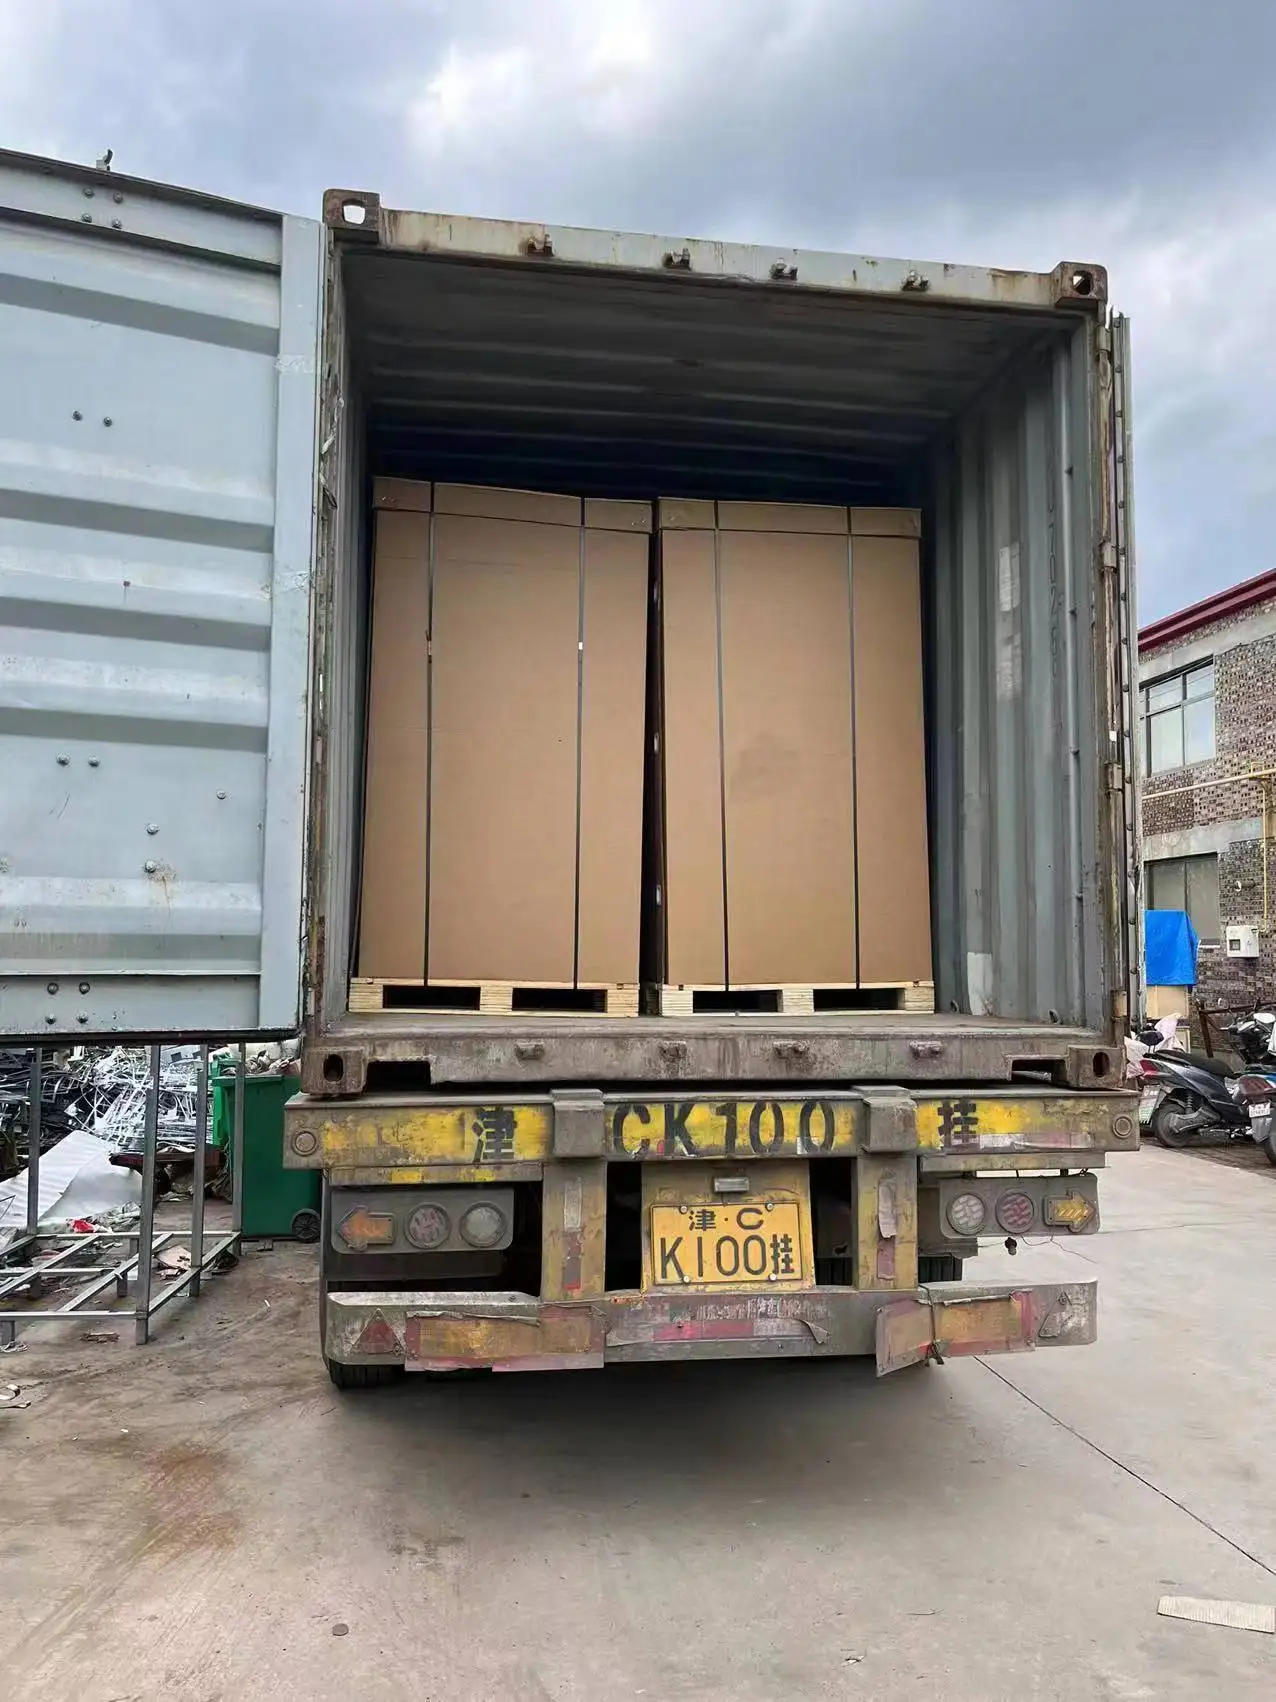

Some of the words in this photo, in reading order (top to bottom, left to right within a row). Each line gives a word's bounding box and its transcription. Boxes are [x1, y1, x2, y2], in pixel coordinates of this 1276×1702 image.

[472, 1105, 518, 1164] 津
[612, 1100, 836, 1159] CK100
[937, 1098, 980, 1152] 挂
[659, 1233, 795, 1279] K100挂
